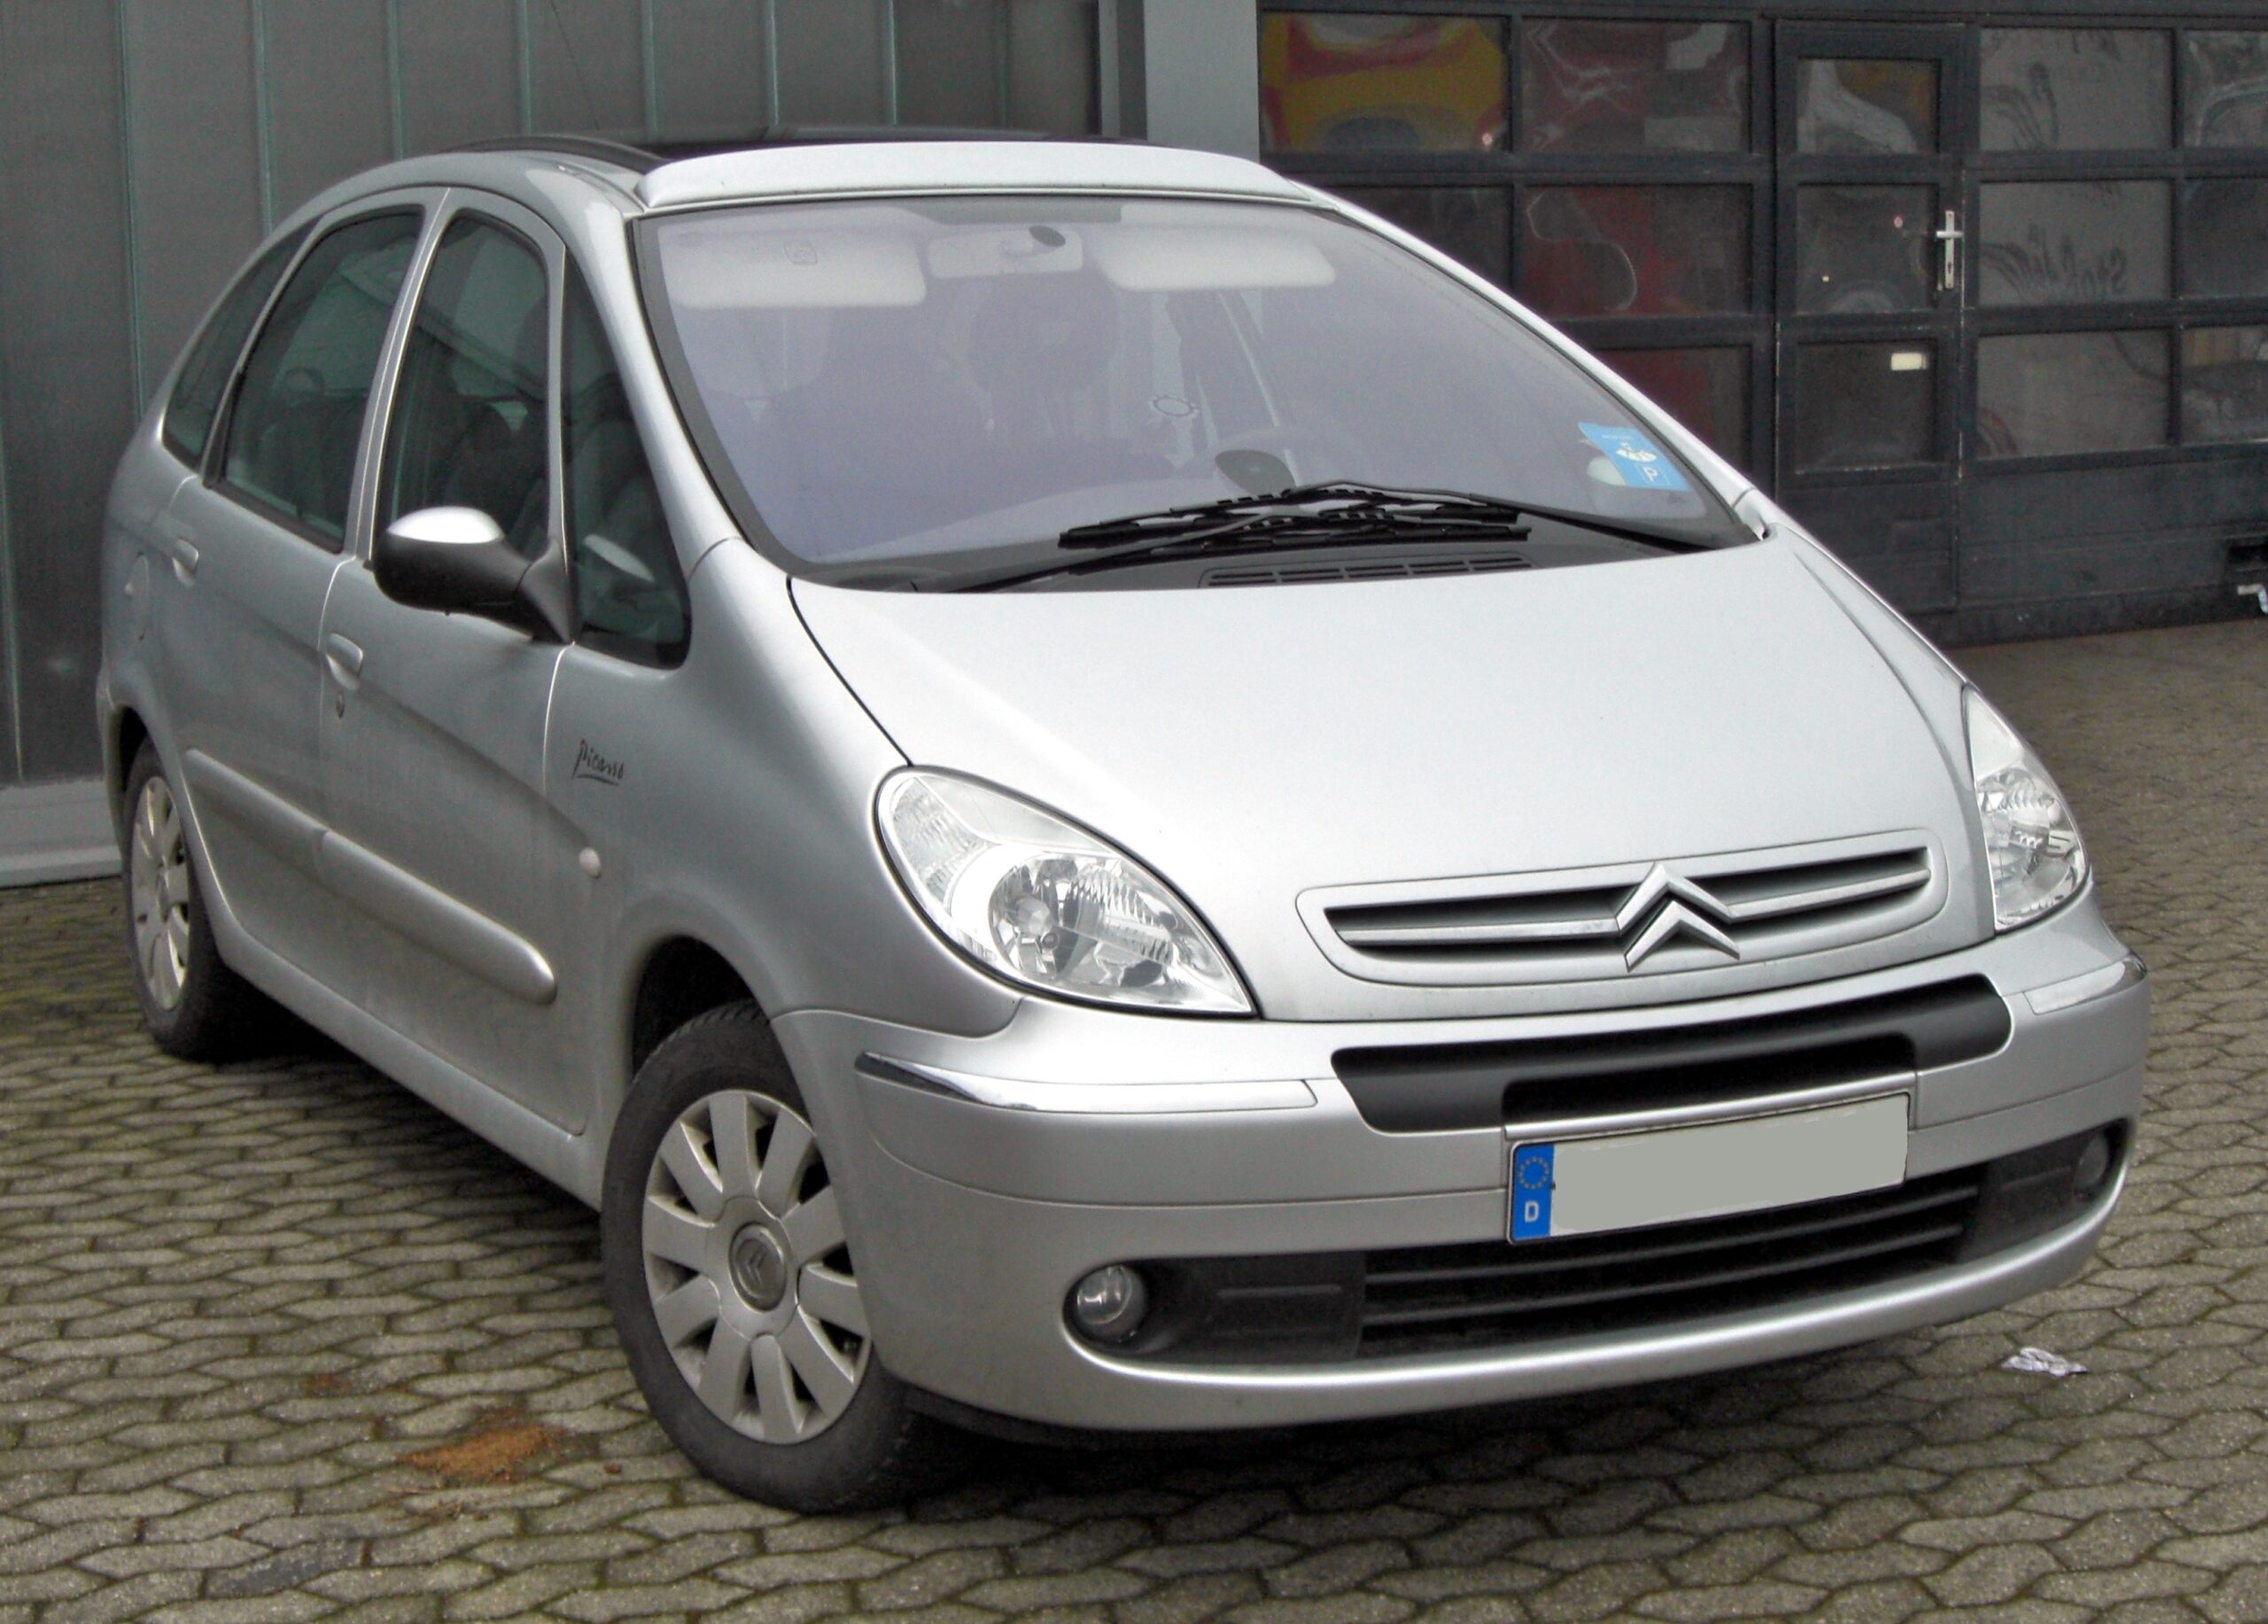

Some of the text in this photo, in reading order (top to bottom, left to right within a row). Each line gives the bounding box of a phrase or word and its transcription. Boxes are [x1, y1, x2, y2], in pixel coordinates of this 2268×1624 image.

[1643, 466, 1658, 482] P
[571, 738, 624, 781] Picasso
[1524, 1200, 1540, 1224] D
